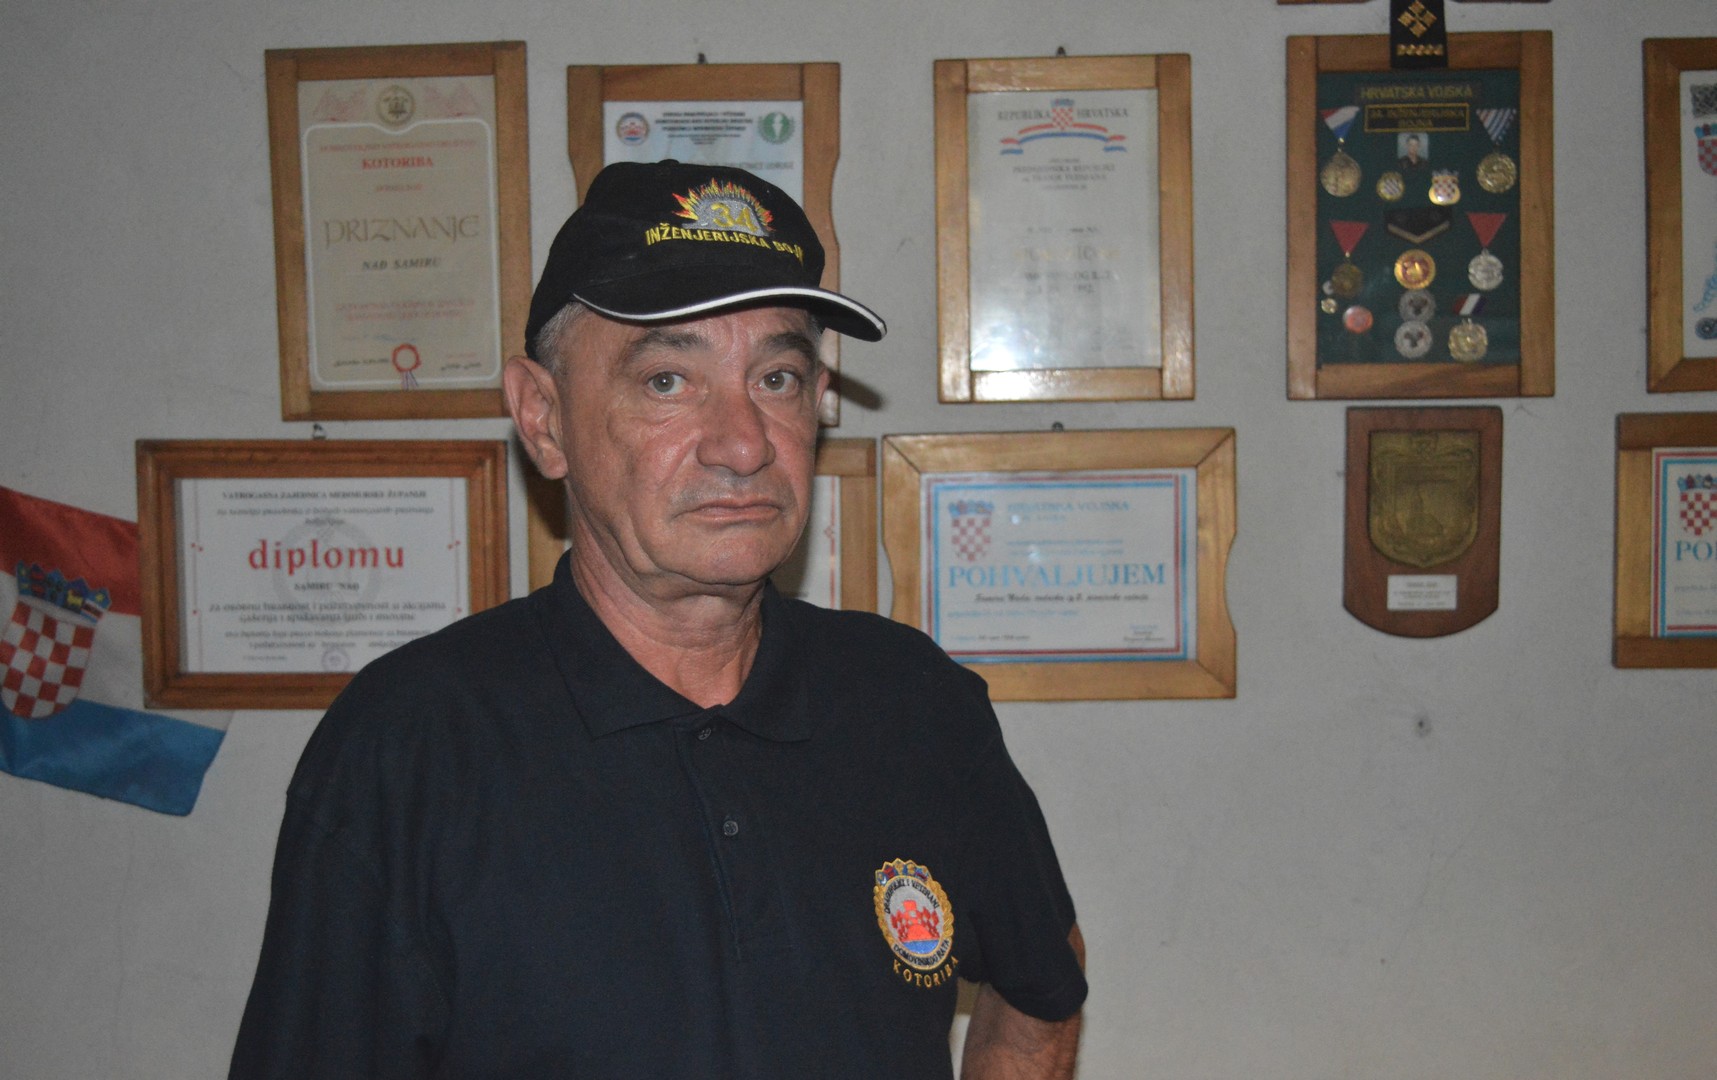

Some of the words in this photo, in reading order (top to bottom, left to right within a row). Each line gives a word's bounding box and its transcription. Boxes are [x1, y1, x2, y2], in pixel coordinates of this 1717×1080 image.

[1360, 86, 1424, 98] HRVATSKA
[1427, 84, 1473, 97] VOJSKA
[997, 110, 1050, 120] REPUBLIKA
[1076, 108, 1129, 118] HRVATSKA
[361, 156, 434, 170] KOTORIBA
[711, 202, 758, 232] 34
[323, 215, 480, 250] PRIZNANJE
[645, 222, 771, 249] INŽENJERIJSKA
[248, 539, 405, 575] diplomu
[1675, 540, 1717, 561] PO
[948, 562, 1166, 588] POHVALJUJEM
[893, 955, 959, 988] KOTORIBA
